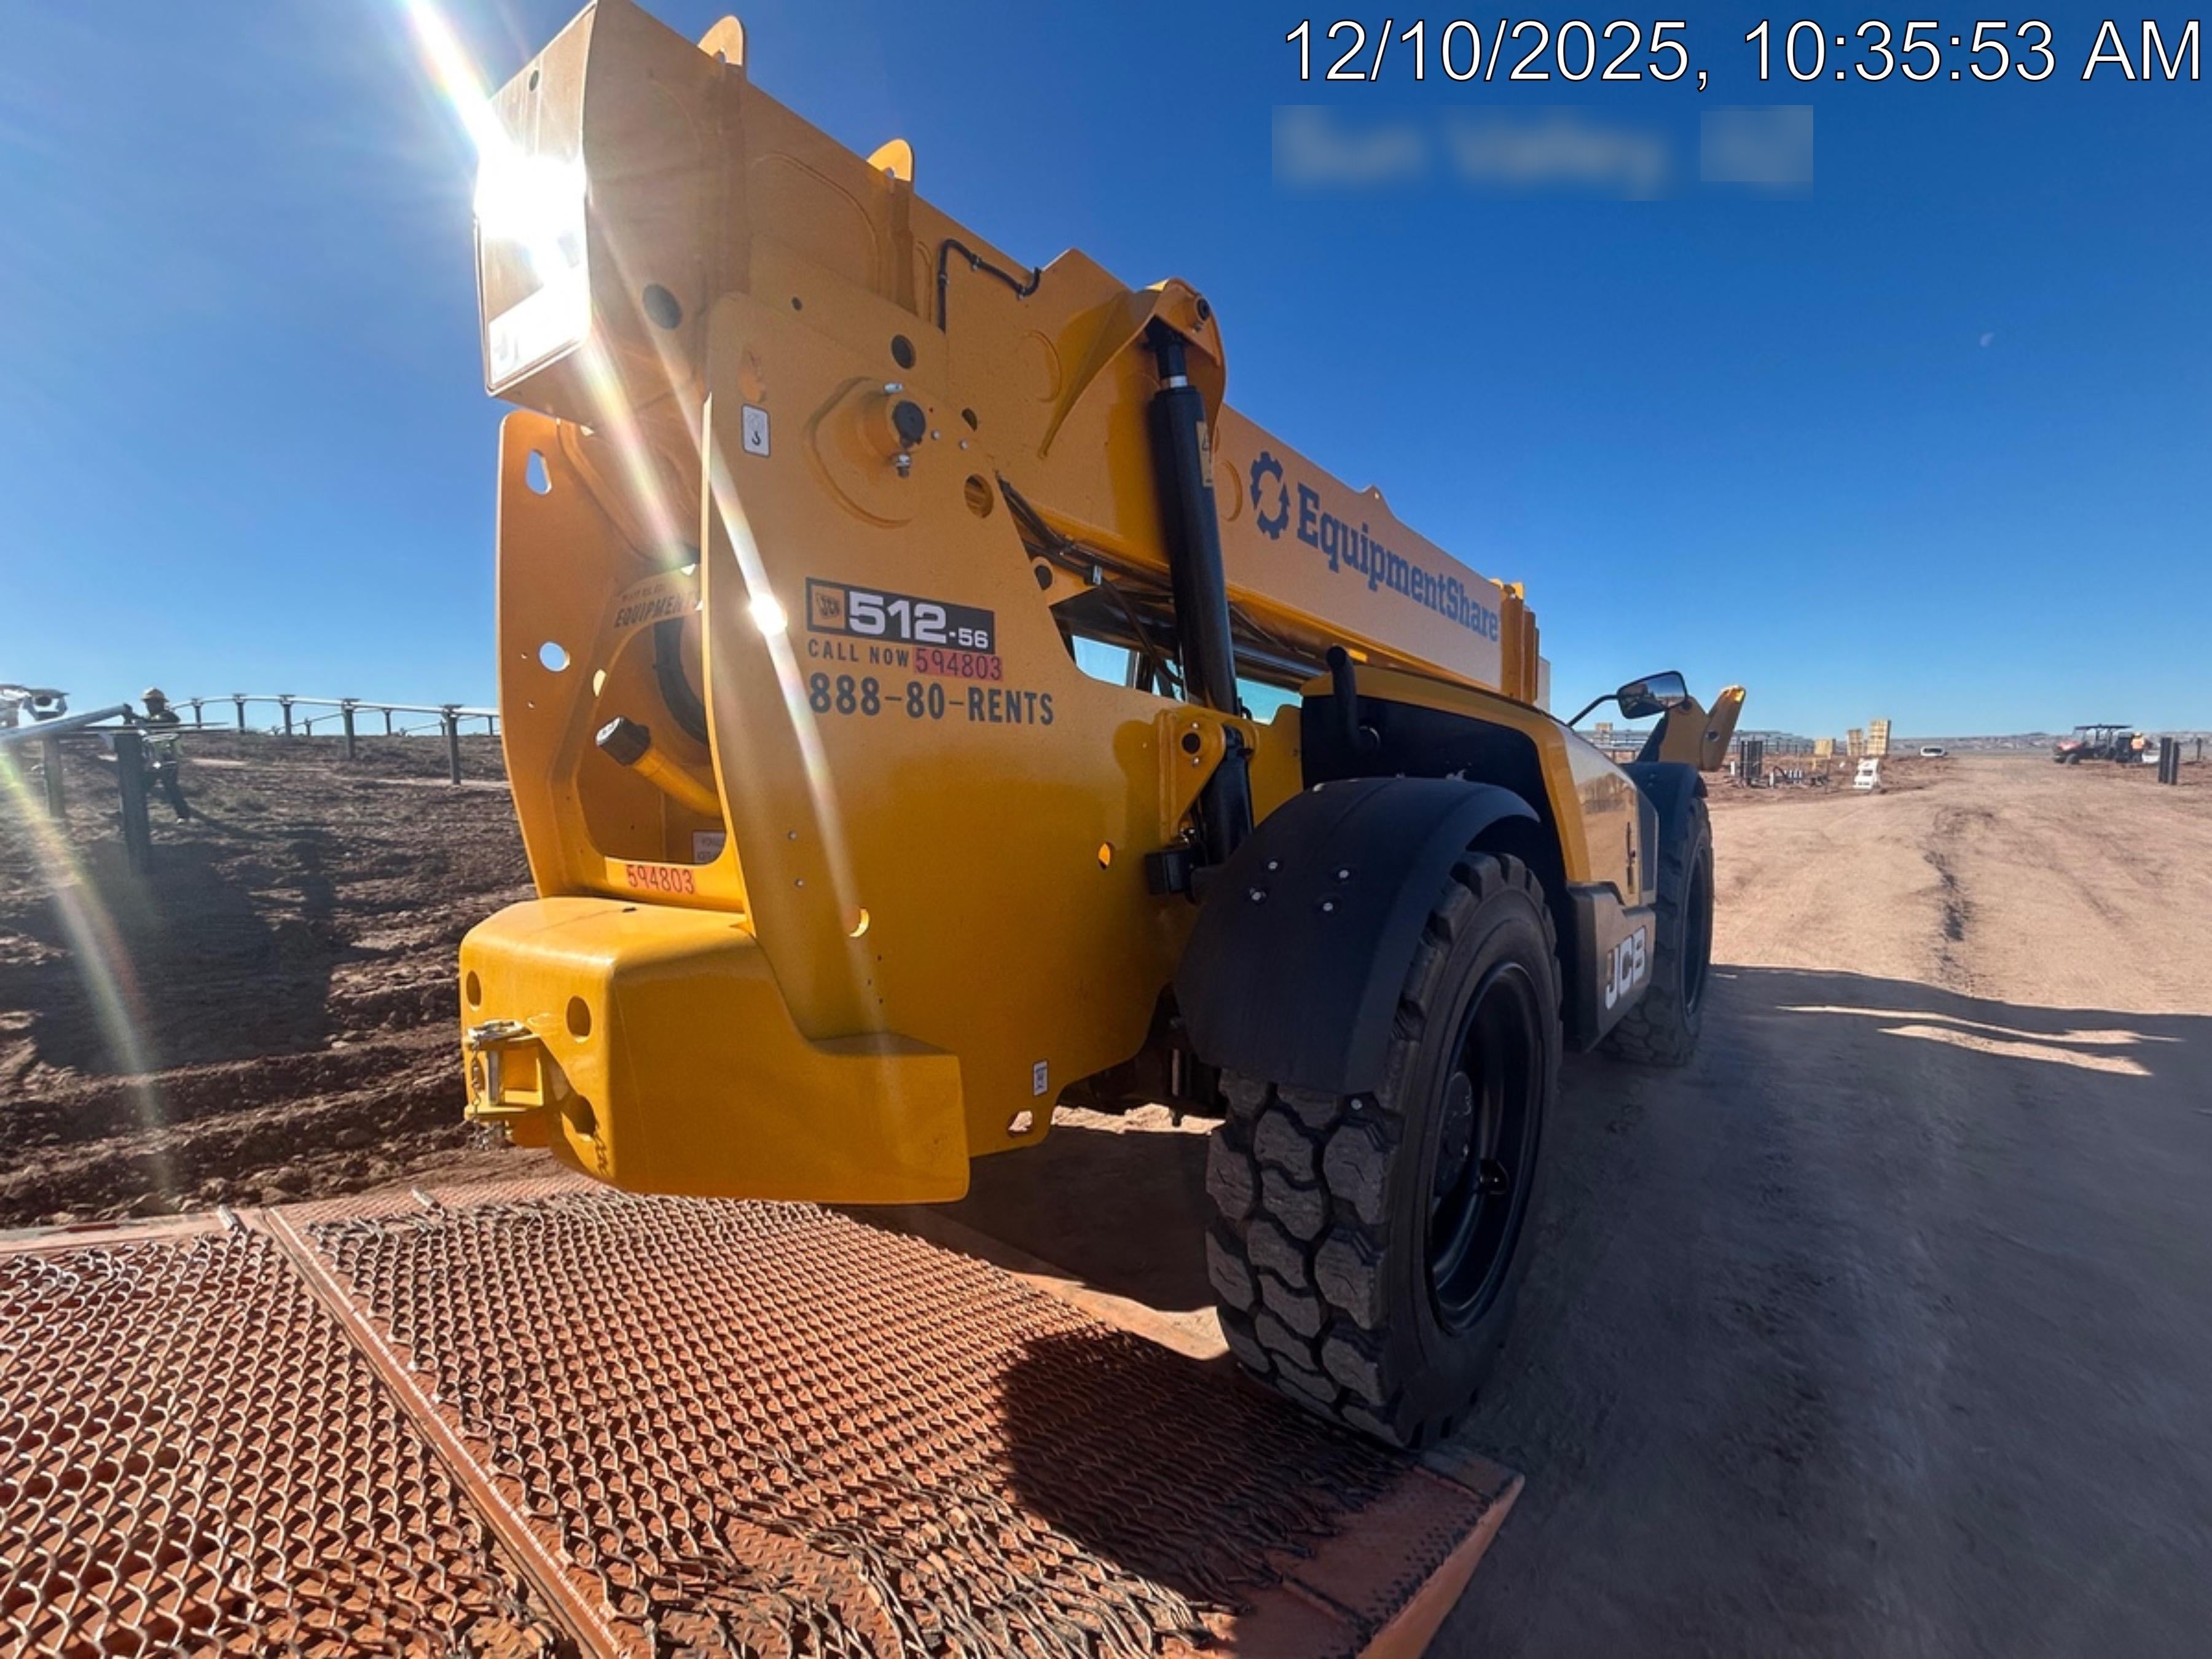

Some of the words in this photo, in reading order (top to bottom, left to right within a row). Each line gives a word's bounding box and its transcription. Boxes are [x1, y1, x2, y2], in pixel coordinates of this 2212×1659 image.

[1298, 482, 1499, 642] EquipmentShare
[808, 639, 859, 662] CALL
[869, 646, 909, 667] NOW
[916, 648, 1002, 681] 594803
[809, 672, 1054, 726] 888-80-RENTS
[626, 864, 694, 895] 594803
[1605, 925, 1646, 1010] JCB
